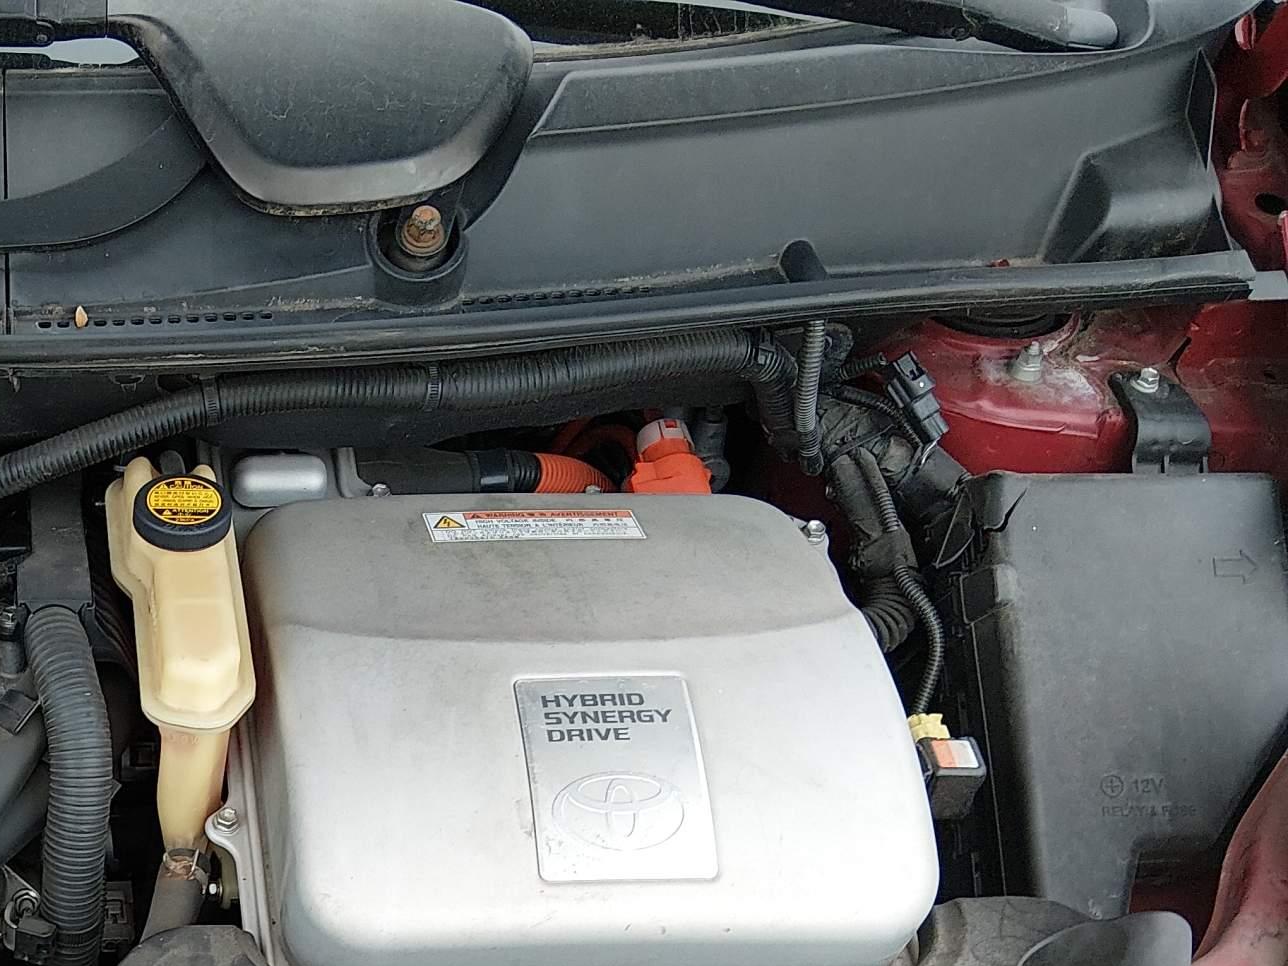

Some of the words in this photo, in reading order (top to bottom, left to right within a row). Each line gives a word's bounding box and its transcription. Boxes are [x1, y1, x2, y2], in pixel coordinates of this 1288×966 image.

[540, 692, 645, 708] HYBRID
[543, 709, 673, 726] SYNERGY
[546, 727, 631, 743] DRIVE
[1131, 777, 1165, 794] 12V
